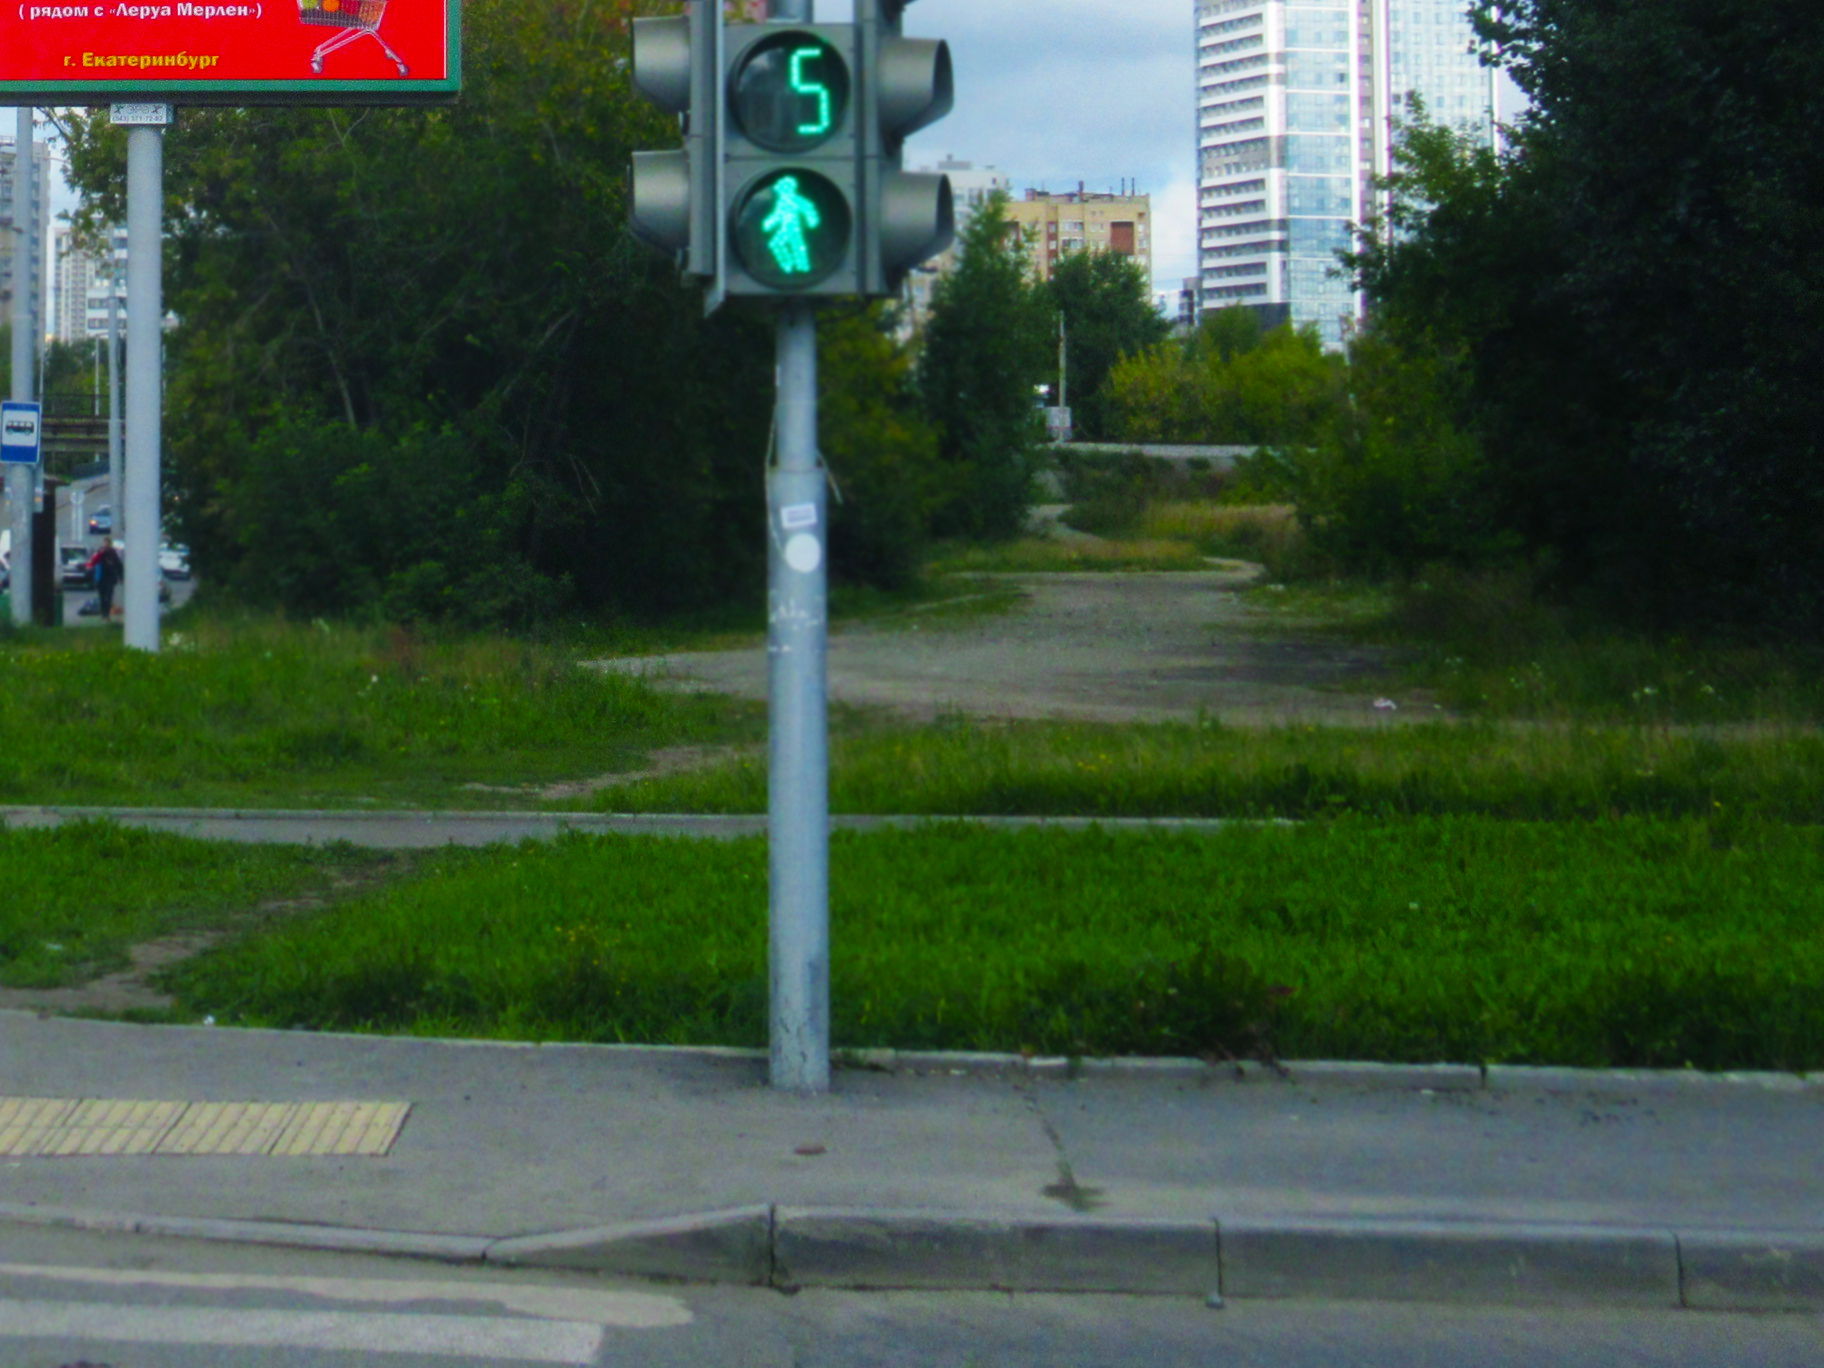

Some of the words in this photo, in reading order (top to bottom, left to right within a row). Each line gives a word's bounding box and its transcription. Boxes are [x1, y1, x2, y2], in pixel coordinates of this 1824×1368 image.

[30, 4, 89, 20] рядом
[94, 5, 104, 17] с
[109, 2, 172, 19] «Леруа
[177, 2, 263, 20] Мерлен»)
[63, 55, 76, 67] г.
[82, 51, 220, 69] Екатеринбург
[790, 47, 830, 135] 5
